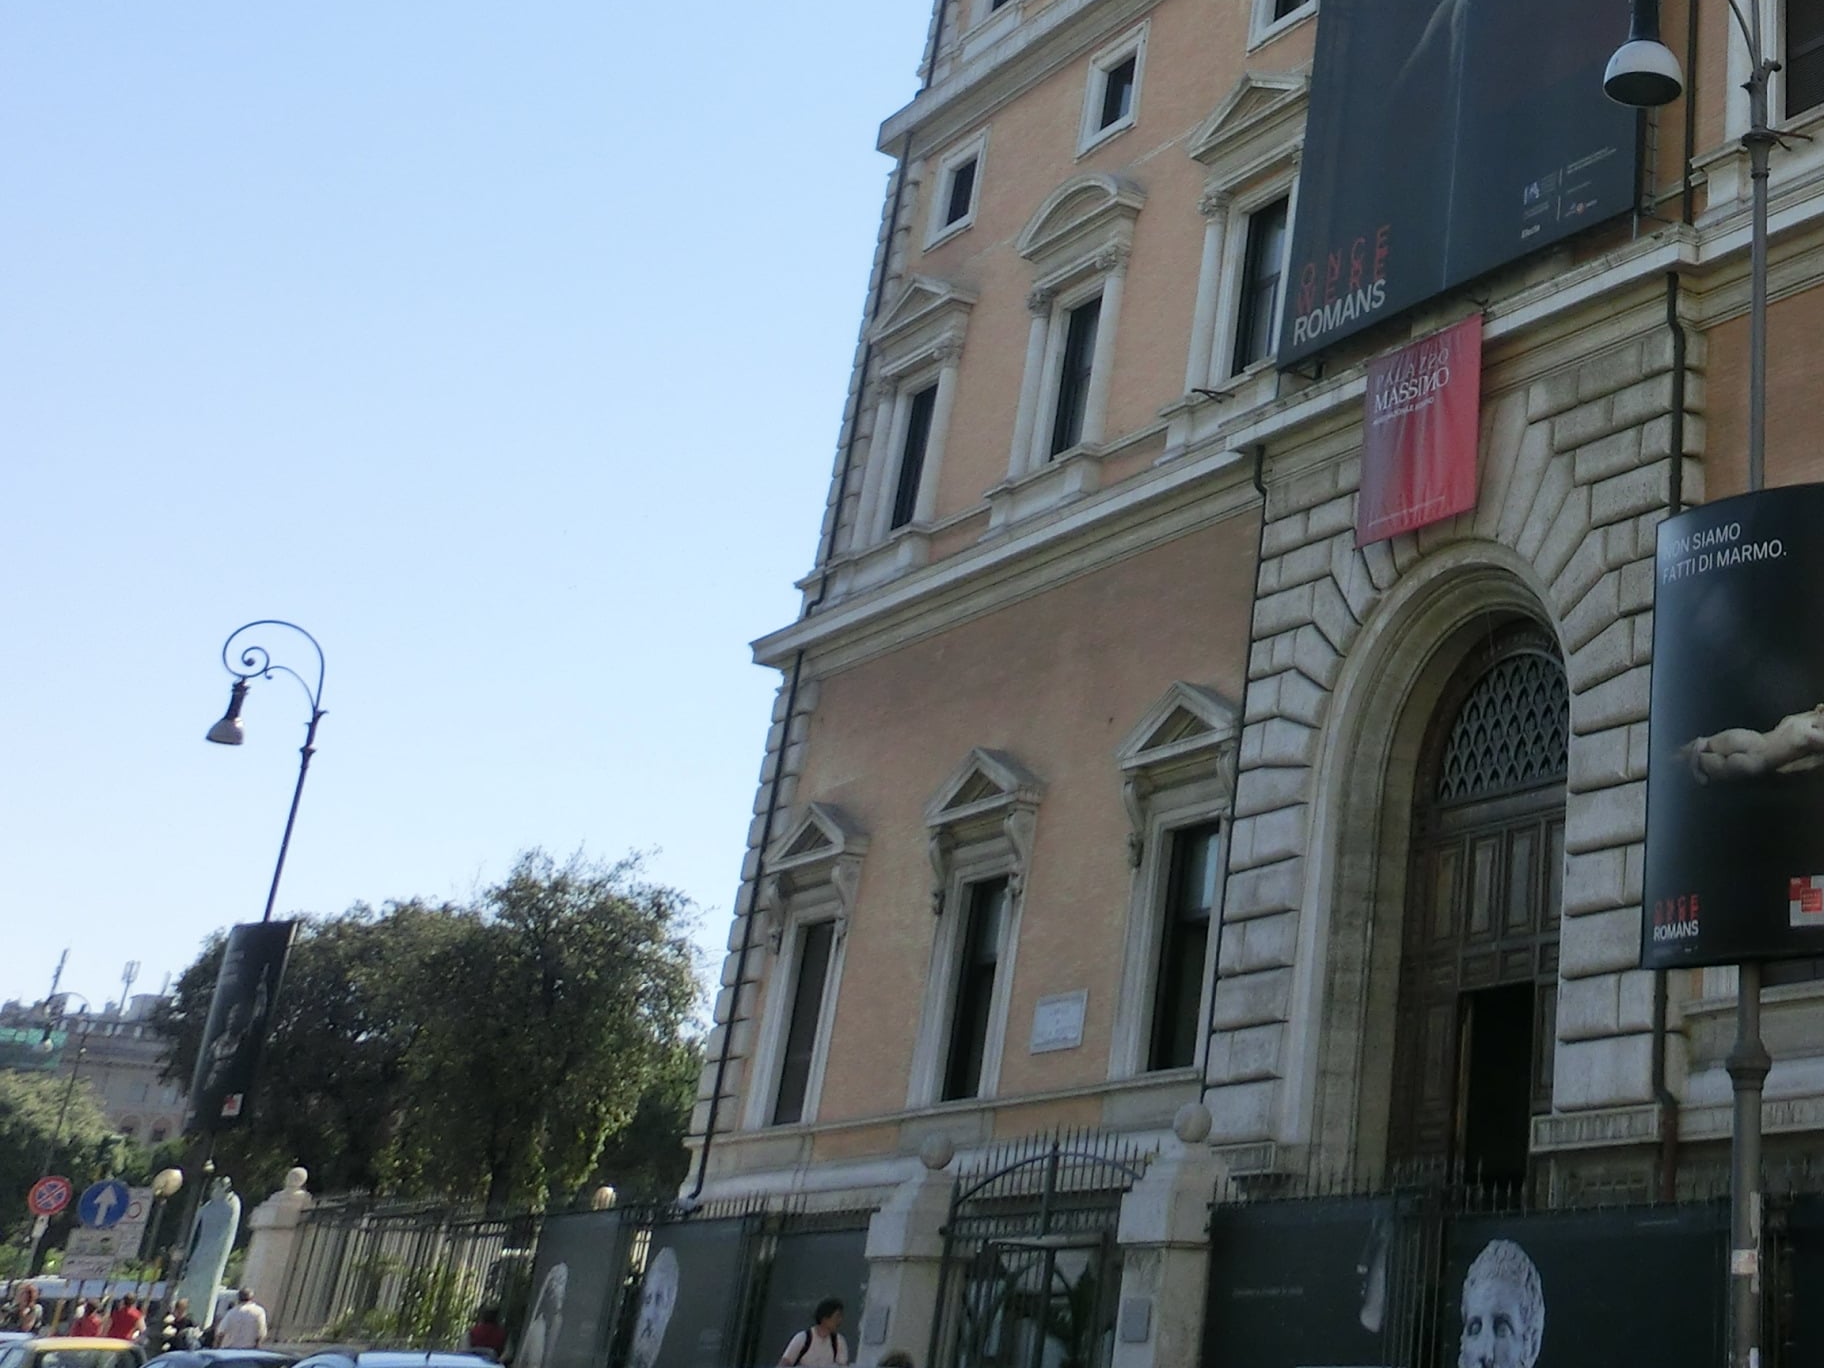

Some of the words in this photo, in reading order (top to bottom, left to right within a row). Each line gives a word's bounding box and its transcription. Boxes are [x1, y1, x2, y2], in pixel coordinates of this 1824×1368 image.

[1301, 223, 1391, 286] ONCE
[1292, 278, 1386, 347] ROMANS
[1374, 367, 1450, 413] MASSIMO
[1663, 536, 1689, 561] NON
[1692, 522, 1741, 551] SIAMO
[1663, 557, 1695, 585] FATTI
[1698, 552, 1713, 573] DI
[1716, 538, 1788, 568] MARMO.
[1653, 919, 1699, 942] ROMANS
